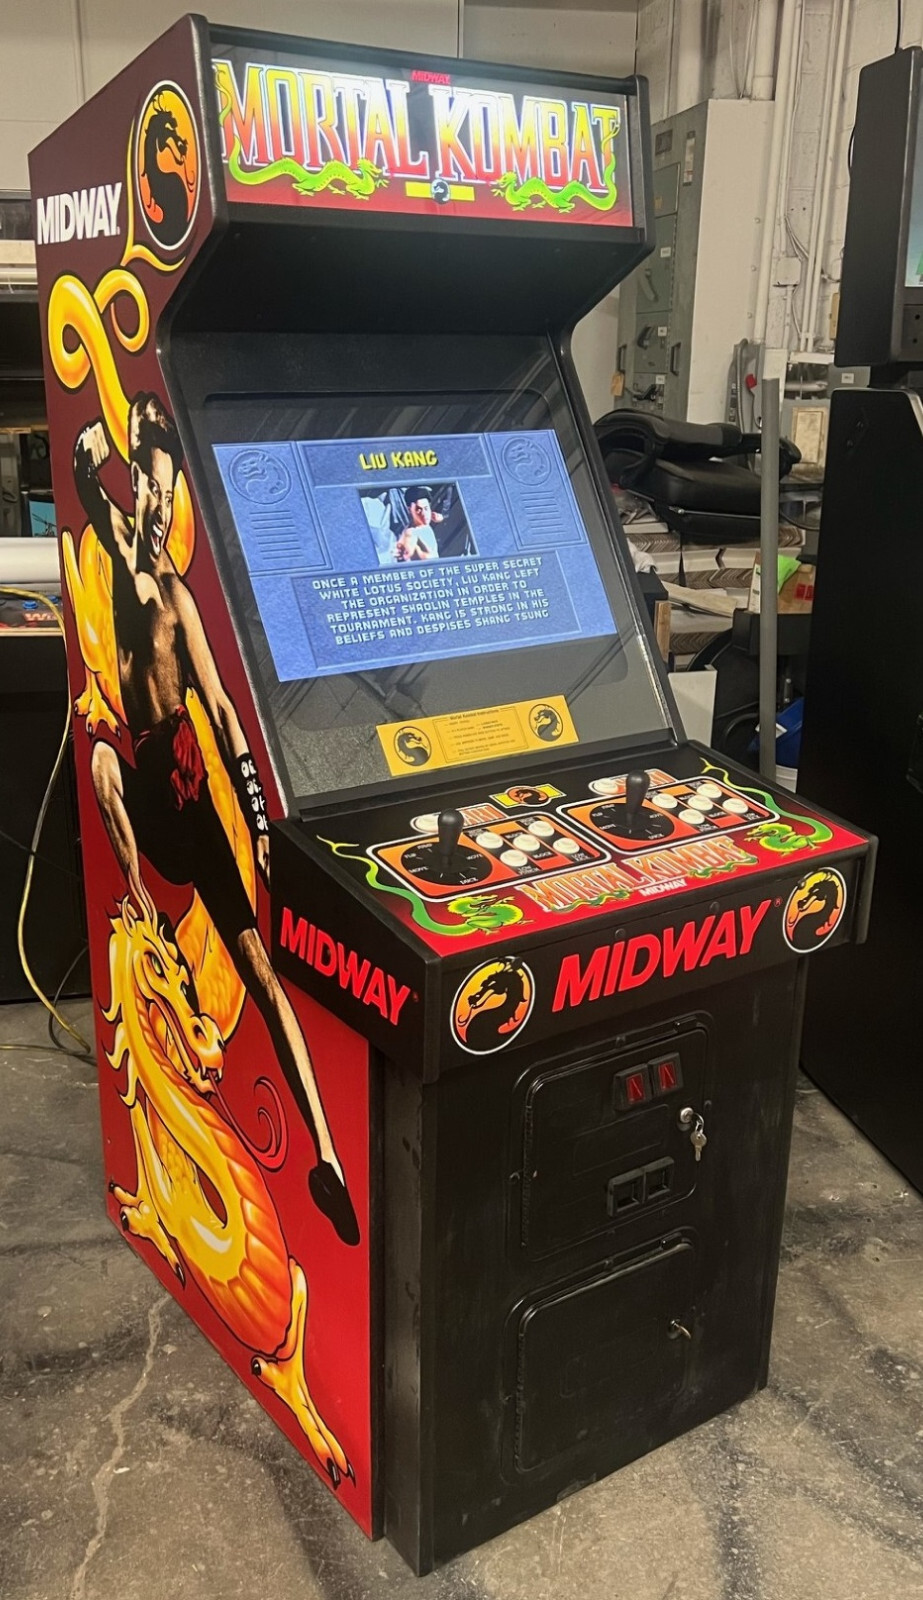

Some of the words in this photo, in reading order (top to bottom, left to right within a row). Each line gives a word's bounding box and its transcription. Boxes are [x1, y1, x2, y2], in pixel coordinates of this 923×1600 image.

[411, 70, 451, 86] MIDWAY
[211, 58, 430, 180] MORTAL
[429, 84, 621, 194] KOMBAT
[359, 452, 388, 470] LIU
[391, 449, 438, 468] KANG
[312, 577, 347, 590] ONCE
[350, 576, 359, 586] A
[362, 570, 416, 585] MEMBER
[419, 568, 435, 578] OF
[438, 565, 461, 576] THE
[464, 561, 500, 574] SUPER
[502, 556, 542, 570] SECRET
[319, 587, 360, 600] WHITE
[363, 582, 402, 596] LOTUS
[461, 574, 479, 585] LIU
[482, 571, 511, 582] KANG
[514, 567, 540, 579] LEFT
[326, 606, 396, 623] REPRESENT
[401, 599, 451, 614] SHAOLIN
[453, 593, 506, 608] TEMPLES
[508, 591, 520, 601] IN
[523, 588, 545, 599] THE
[341, 598, 366, 610] THE
[369, 588, 454, 607] ORGANIZATION
[457, 586, 470, 596] IN
[473, 582, 510, 594] ORDER
[512, 579, 528, 590] TO
[329, 615, 418, 634] TOURNAMENT.
[421, 610, 452, 623] KANG
[455, 609, 467, 618] IS
[470, 603, 514, 617] STRONG
[516, 601, 529, 611] IN
[531, 598, 549, 609] HIS
[335, 630, 386, 646] BELIEFS
[389, 627, 413, 639] AND
[416, 619, 472, 635] DESPISES
[475, 614, 511, 627] SHANG
[514, 609, 549, 622] TSUNG
[514, 862, 650, 912] MORTAL
[621, 835, 746, 887] KOMBAT
[638, 877, 688, 897] MIDWAY
